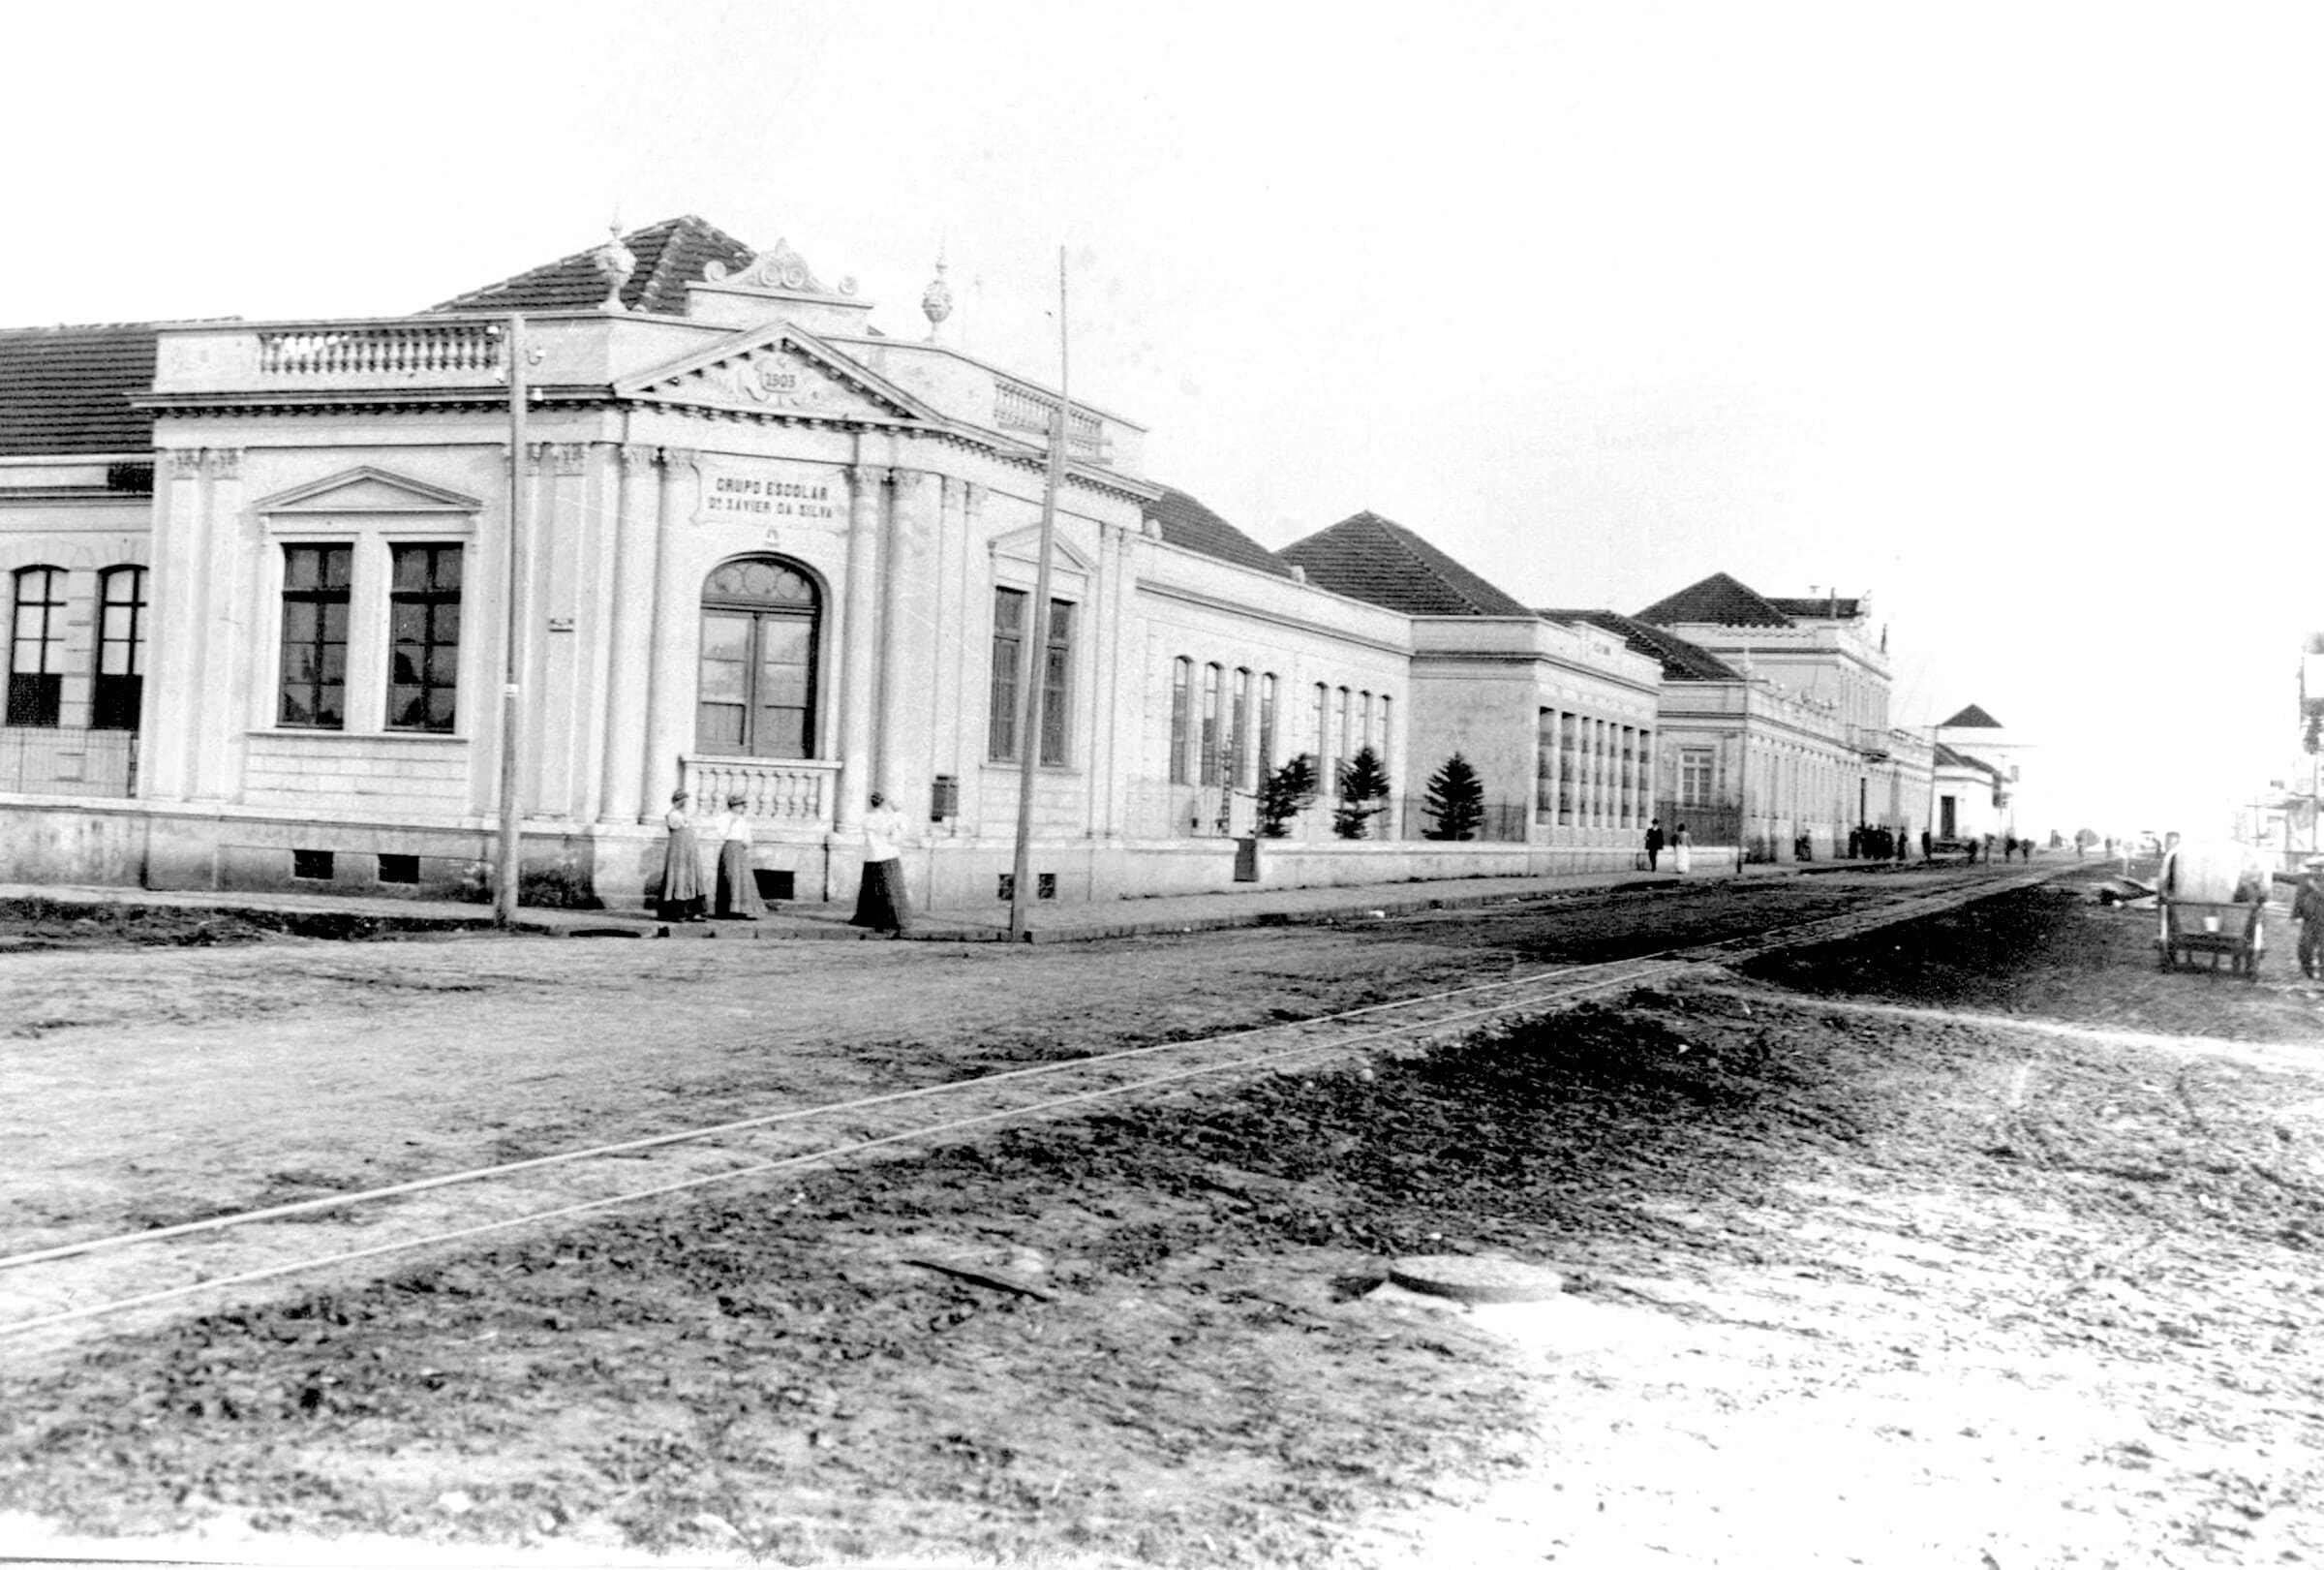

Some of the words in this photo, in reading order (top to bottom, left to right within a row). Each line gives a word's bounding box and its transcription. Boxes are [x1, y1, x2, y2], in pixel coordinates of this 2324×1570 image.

[717, 477, 761, 495] GRUPO
[766, 481, 828, 501] ESCOLAR
[726, 498, 771, 513] XAVIER
[778, 502, 792, 514] DA
[799, 504, 832, 518] SILVA
